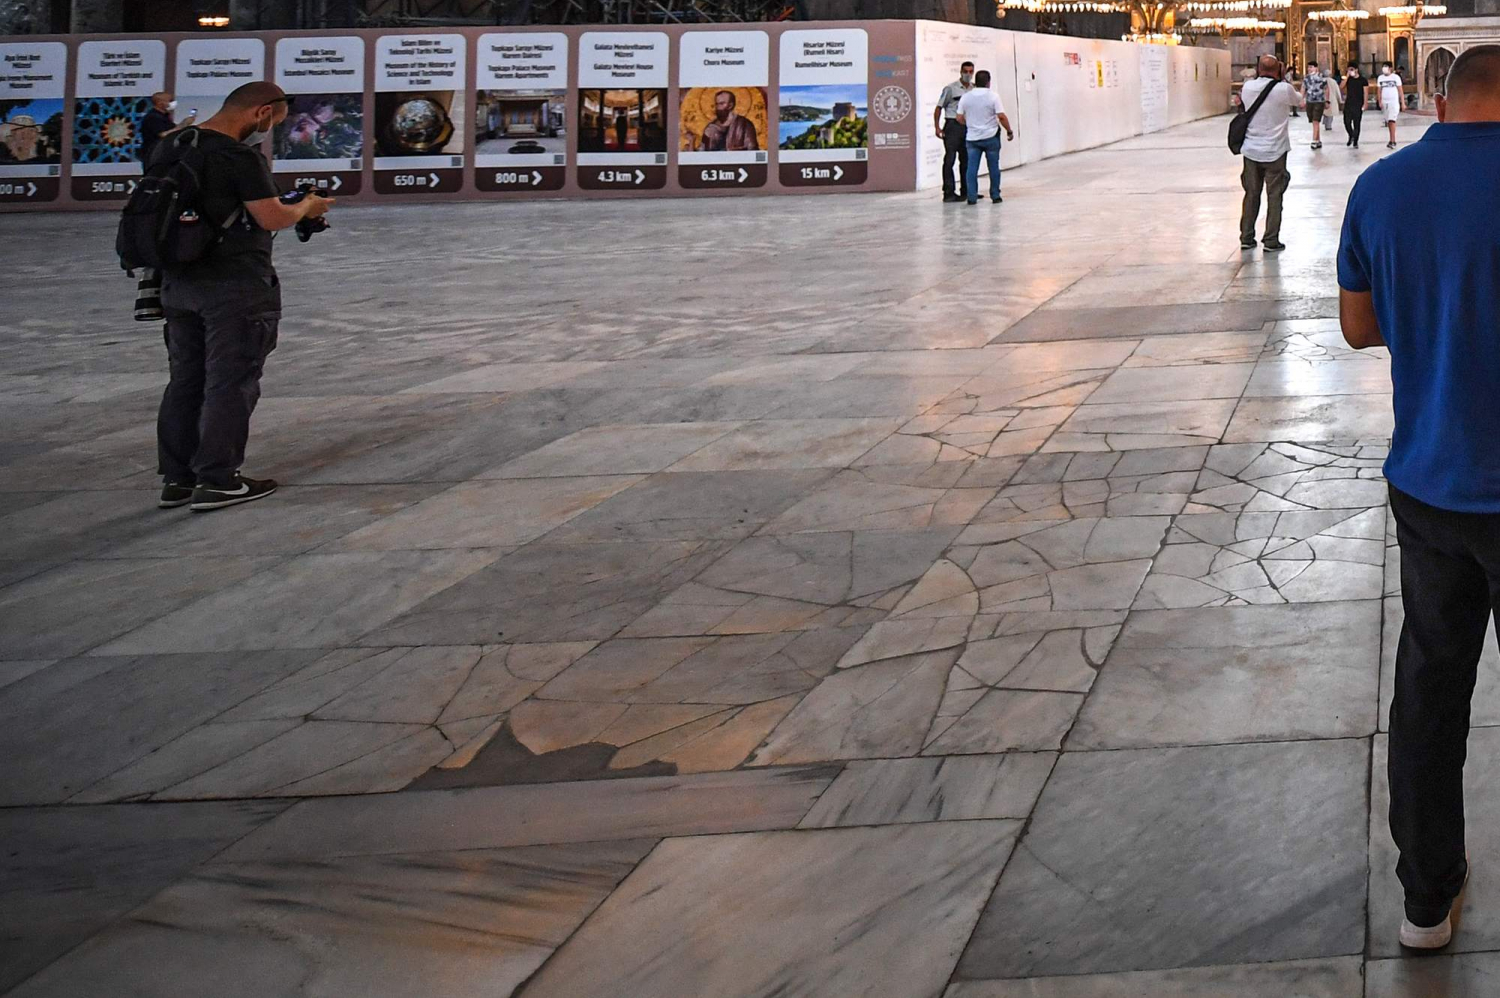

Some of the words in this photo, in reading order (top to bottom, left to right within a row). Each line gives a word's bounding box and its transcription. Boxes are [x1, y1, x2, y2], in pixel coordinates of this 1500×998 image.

[495, 172, 517, 184] 800
[518, 174, 529, 183] m
[597, 171, 615, 182] 4.3
[615, 171, 632, 182] km
[701, 170, 718, 181] 6.3
[718, 170, 735, 180] km
[800, 167, 813, 179] 15
[814, 167, 830, 178] km
[317, 179, 328, 188] m
[394, 175, 415, 186] 650
[416, 176, 427, 186] m
[92, 182, 113, 192] 500
[114, 183, 125, 192] m
